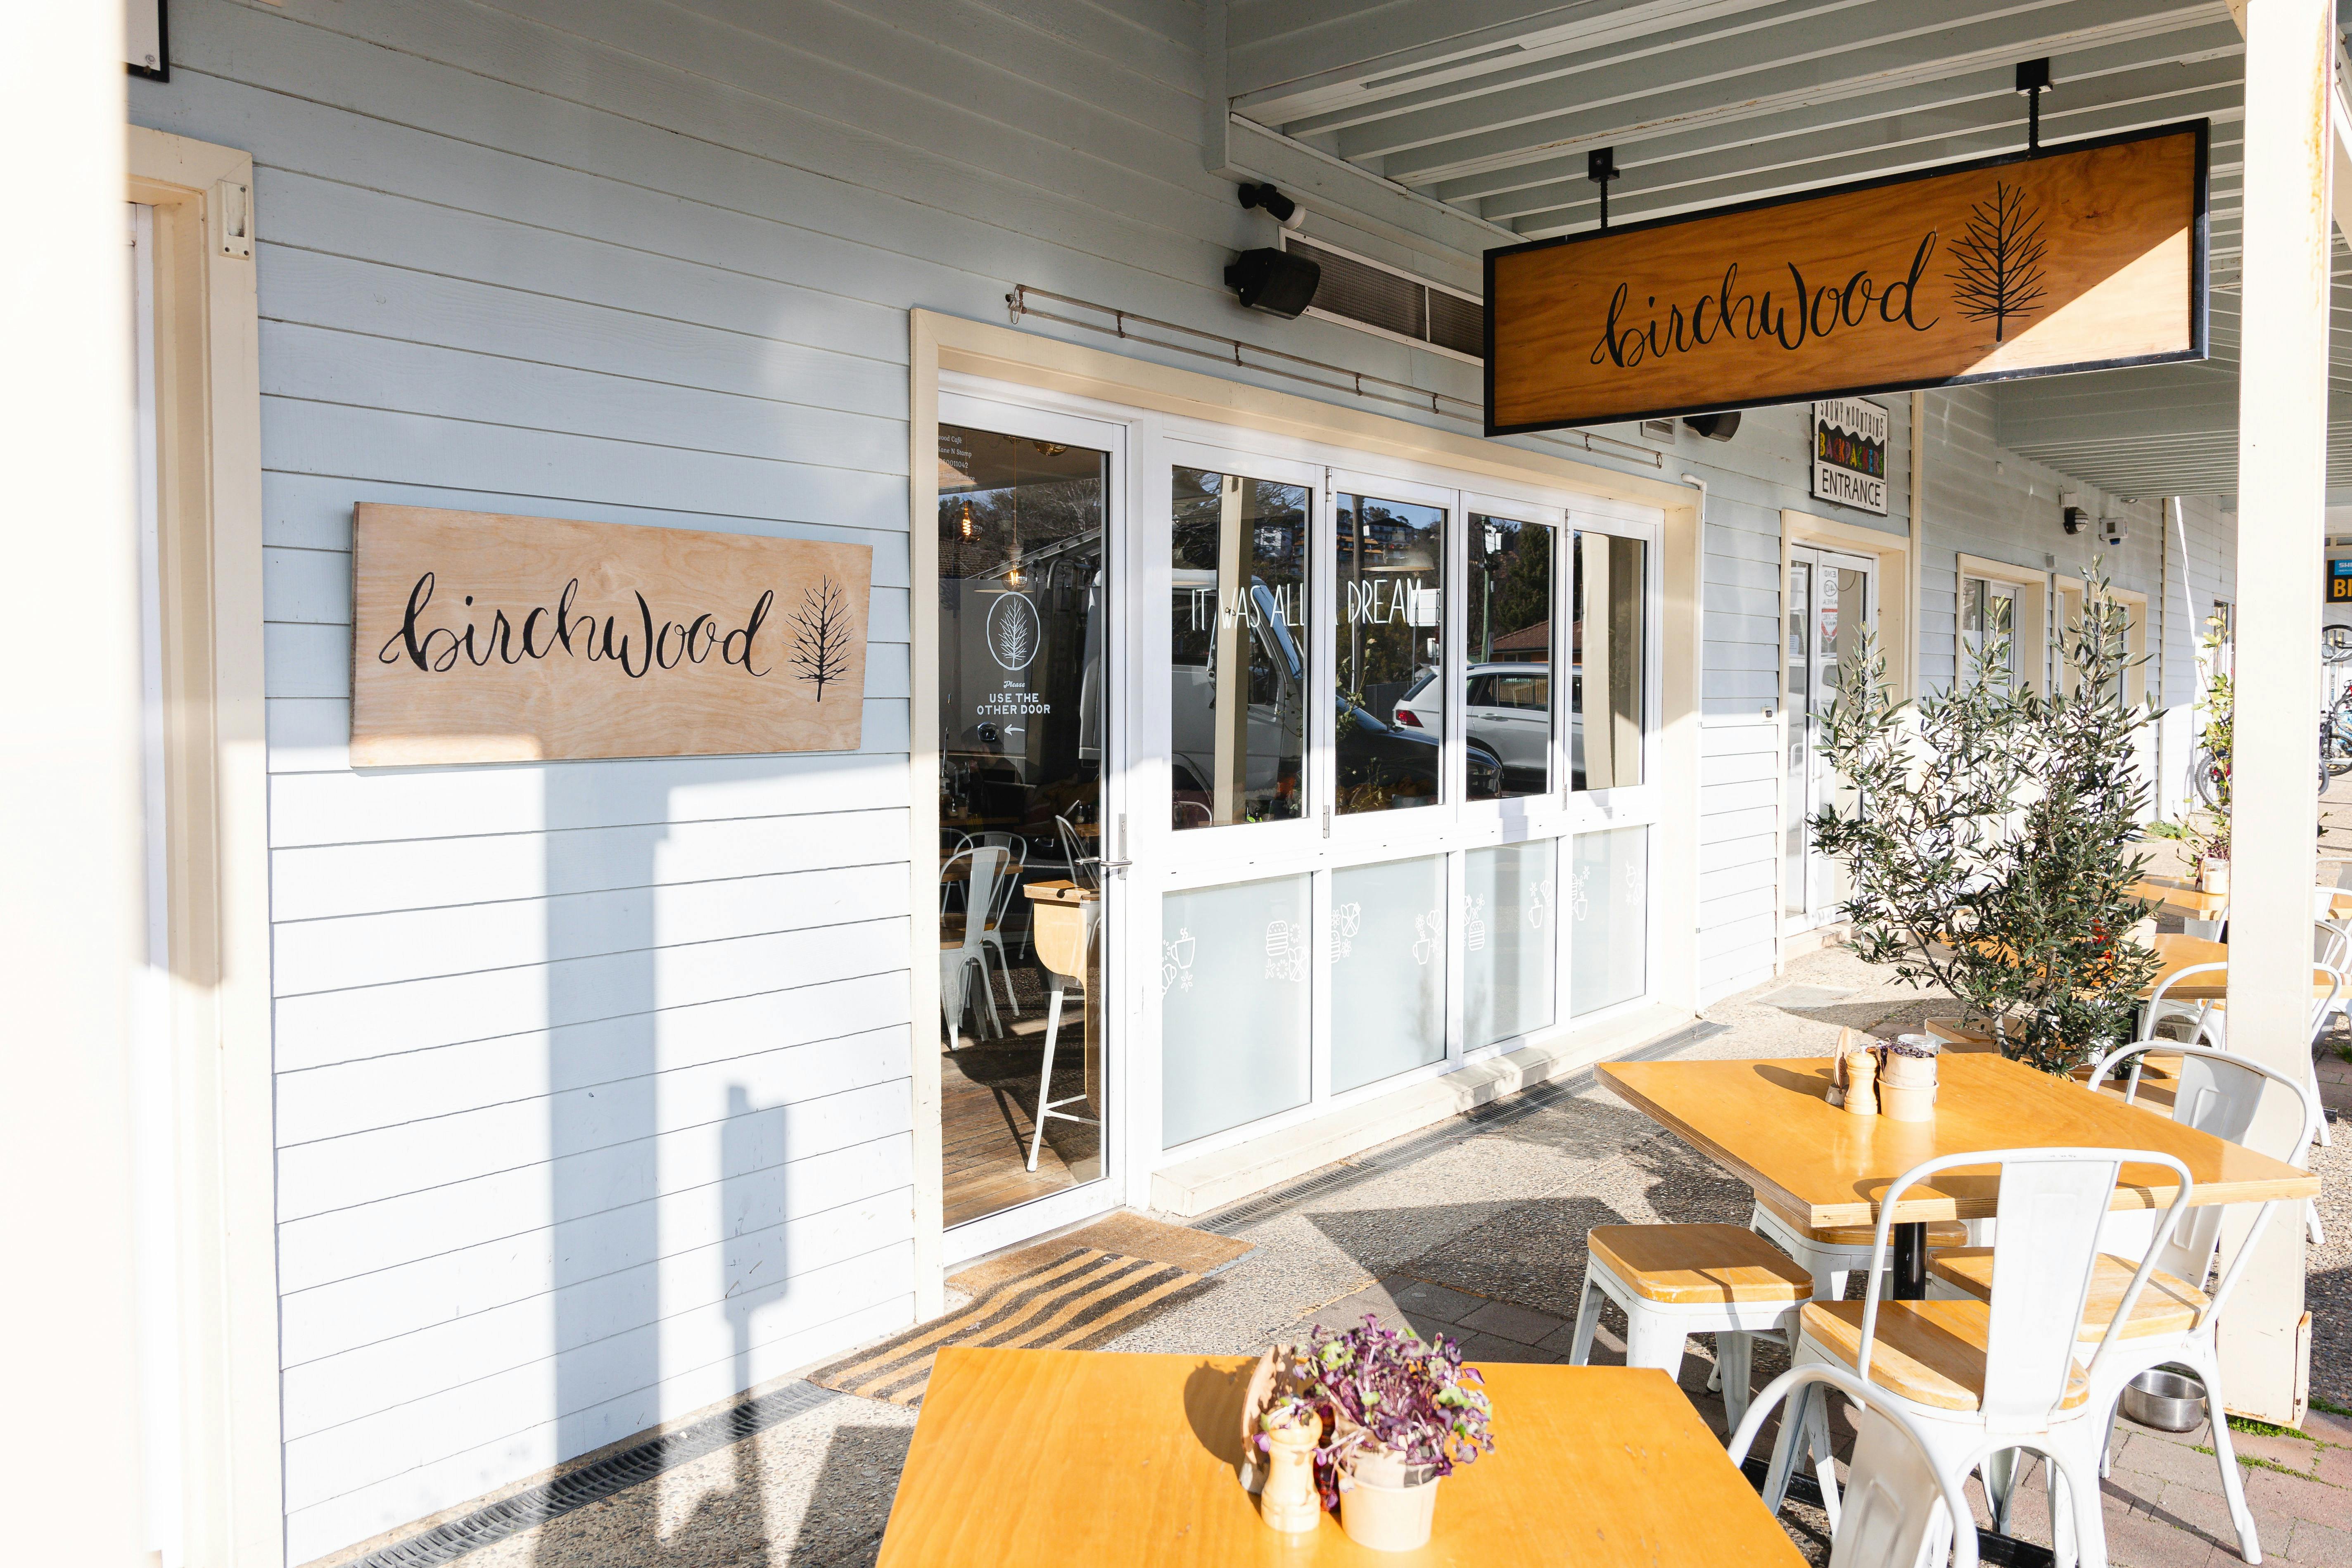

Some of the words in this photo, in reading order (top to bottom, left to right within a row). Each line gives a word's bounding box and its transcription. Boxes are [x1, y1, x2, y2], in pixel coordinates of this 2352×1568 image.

[1820, 400, 1843, 422] SNOWY
[1846, 406, 1883, 438] MOUNTAINS
[956, 449, 972, 458] Stamp
[1820, 432, 1884, 474] BACKPACKERS
[959, 473, 975, 481] licence
[1823, 468, 1880, 507] ENTRANCE
[1192, 588, 1211, 631] IT
[1218, 585, 1260, 629] WAS
[1348, 578, 1421, 624] DREAM
[1003, 680, 1025, 688] Please
[990, 693, 1012, 703] USE
[1016, 693, 1039, 702] THE
[977, 705, 1017, 715] OTHER
[1021, 704, 1050, 714] DOOR
